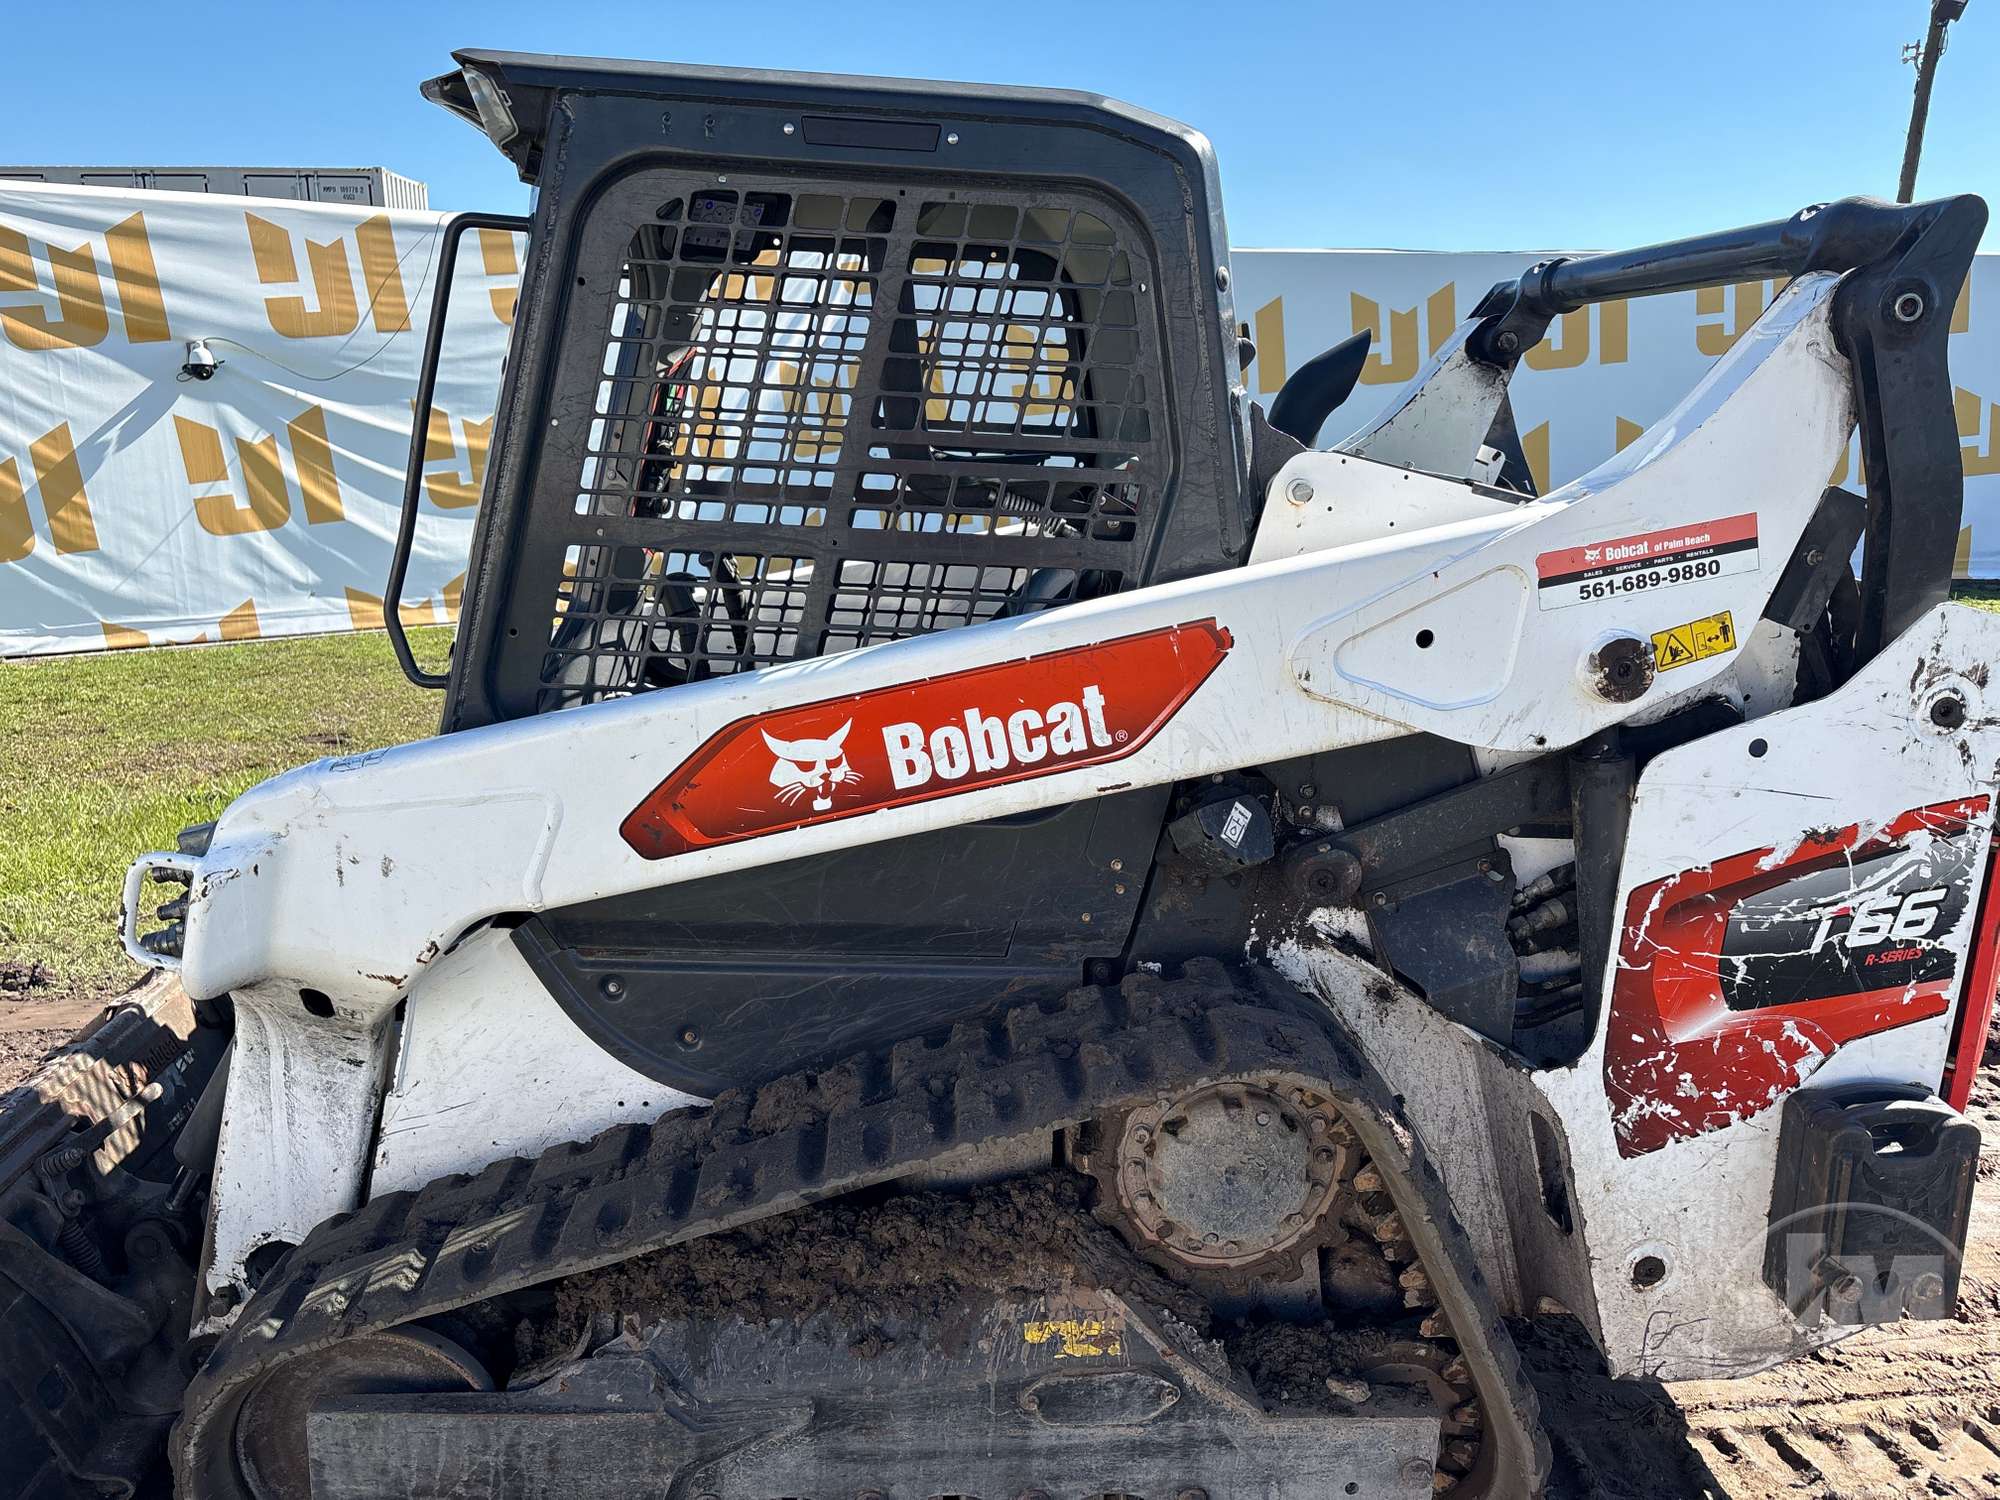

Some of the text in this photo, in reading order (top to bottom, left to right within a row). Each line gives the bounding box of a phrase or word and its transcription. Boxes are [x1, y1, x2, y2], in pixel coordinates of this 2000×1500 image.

[1583, 548, 1714, 578] SALES SERVICE PARTS RENTALS
[1605, 533, 1711, 562] Bobcat of Palm Beach
[1579, 559, 1721, 601] 561-689-9880
[881, 684, 1112, 791] Bobcat
[1808, 887, 1949, 954] T66
[1864, 948, 1924, 966] R-SERIES
